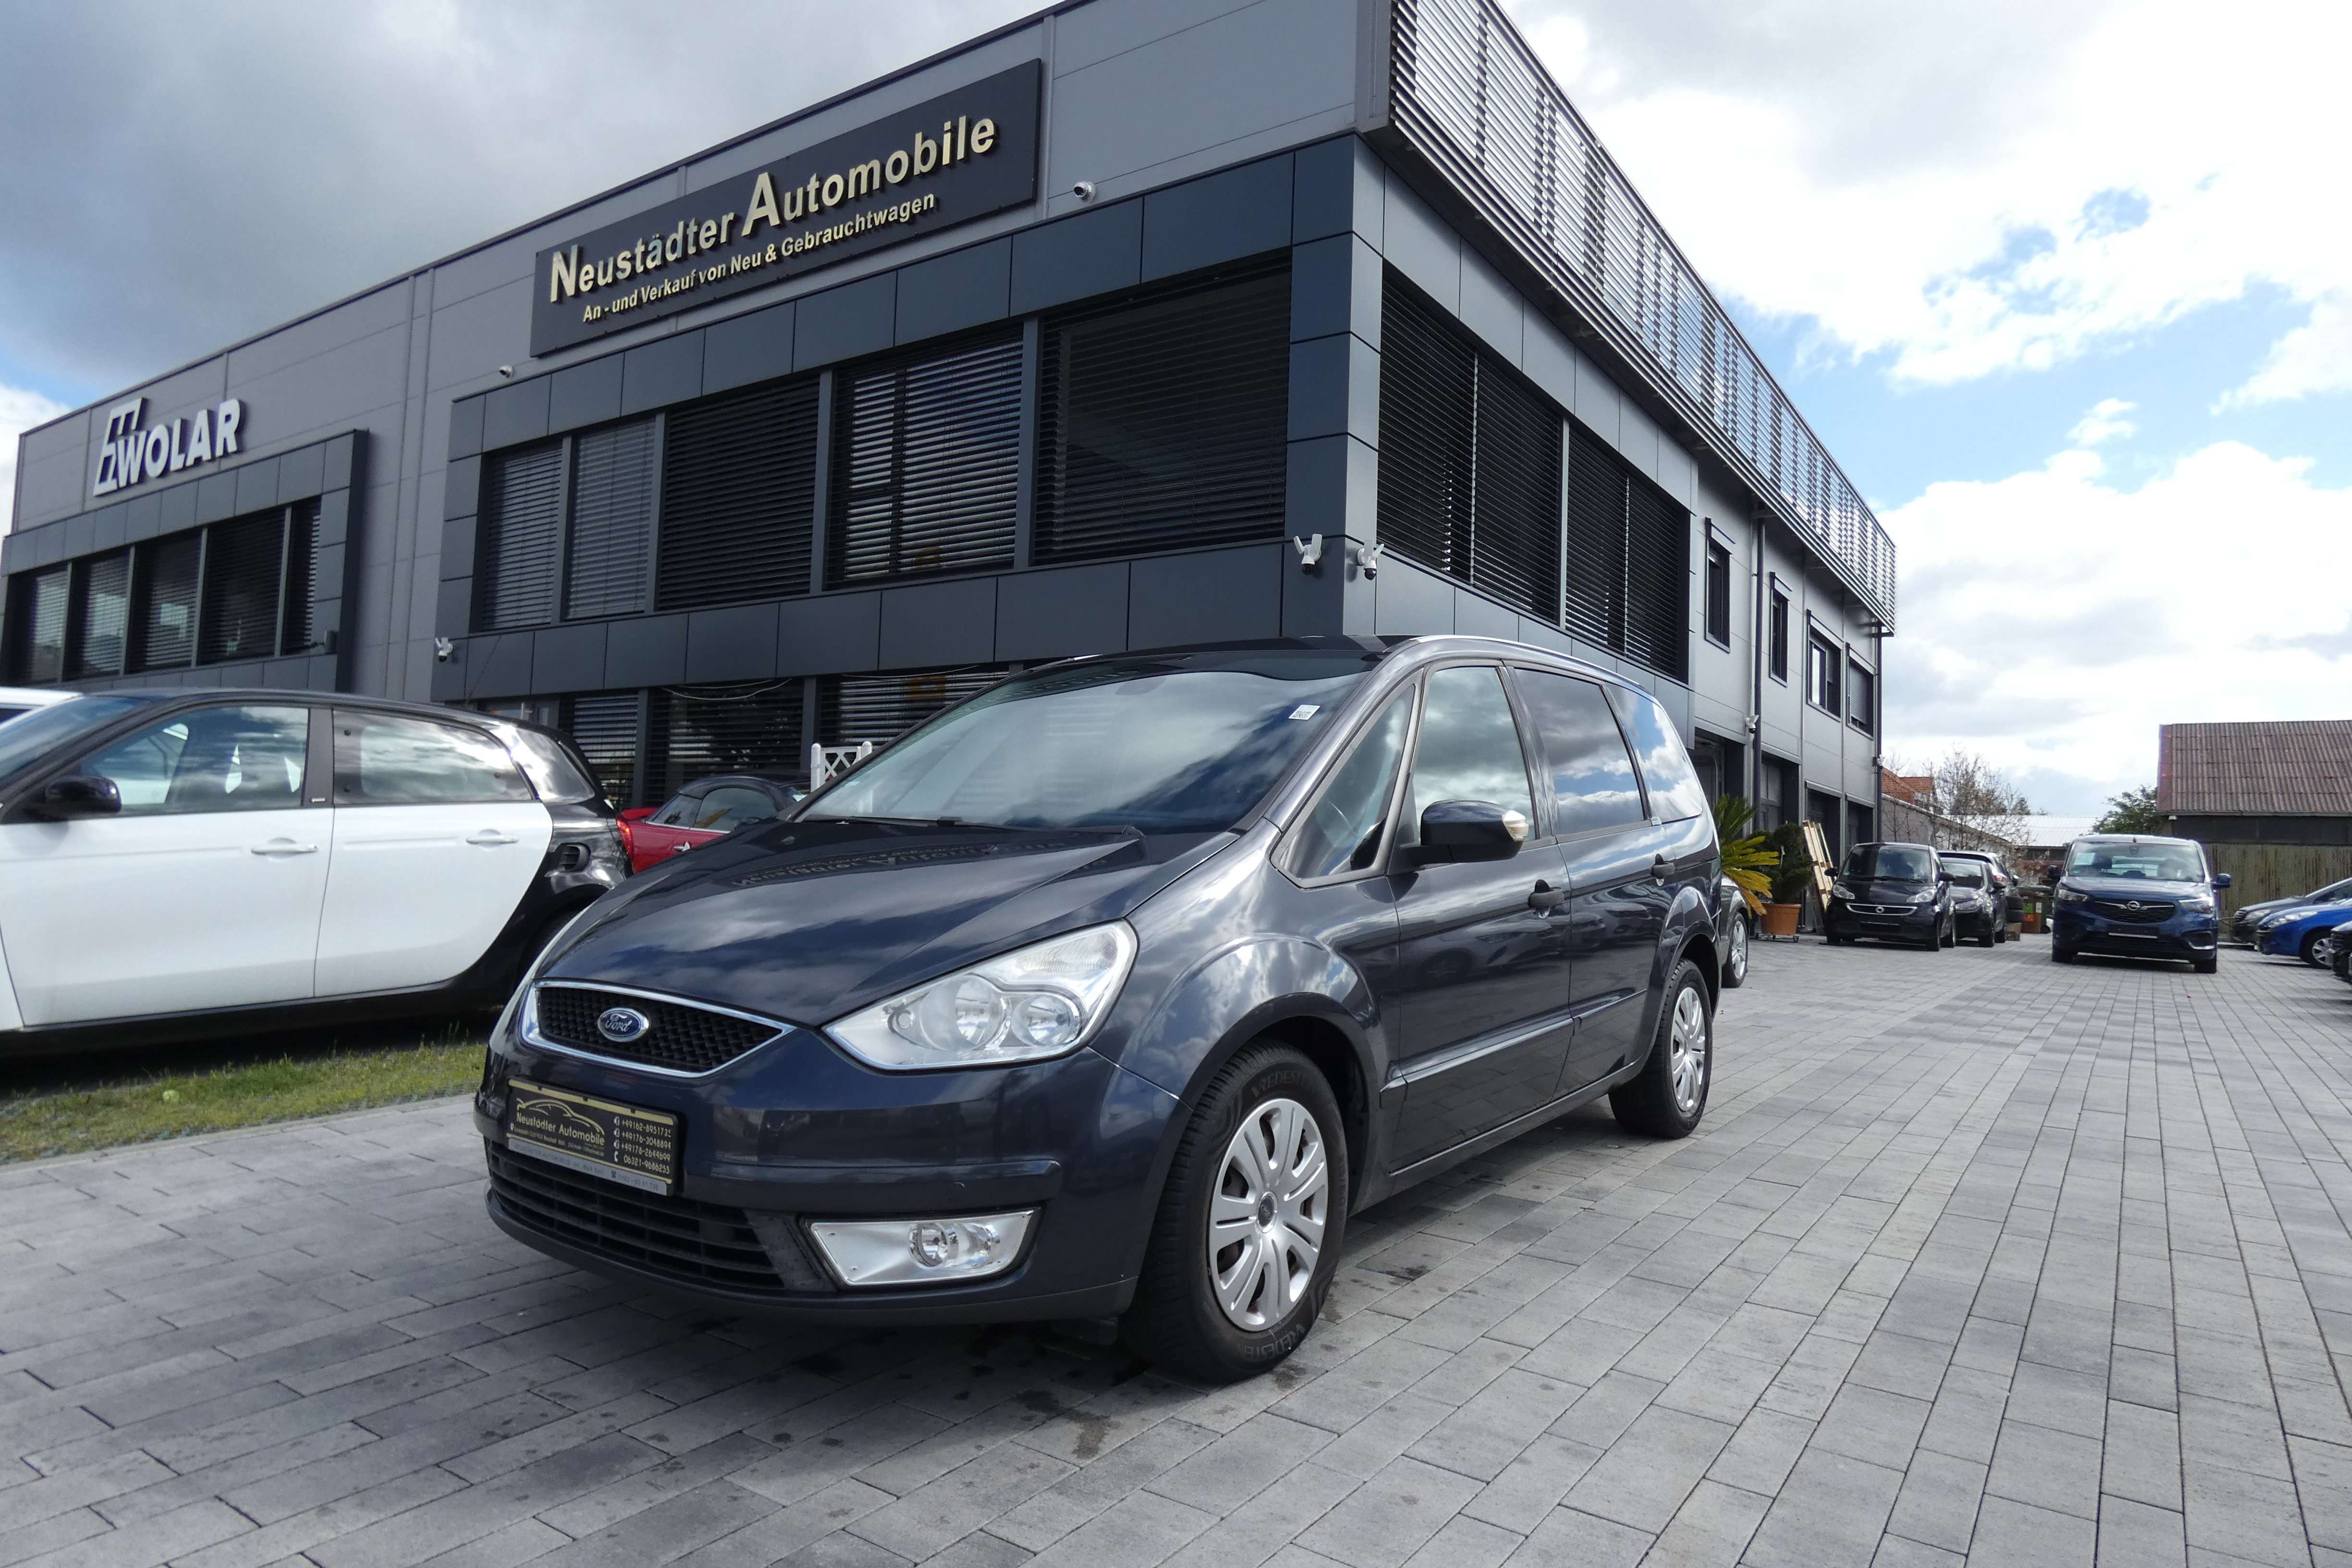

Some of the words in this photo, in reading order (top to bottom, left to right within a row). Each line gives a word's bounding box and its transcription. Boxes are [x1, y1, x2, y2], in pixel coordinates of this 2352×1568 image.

[551, 211, 735, 303] Neustädter
[741, 115, 996, 237] Automobile
[583, 305, 601, 323] An
[612, 288, 637, 313] und
[641, 269, 696, 304] Verkauf
[698, 263, 726, 284] von
[730, 251, 761, 274] Neu
[764, 243, 777, 263] &
[781, 194, 934, 258] Gebrauchtwagen
[605, 1014, 632, 1032] Ford
[516, 1112, 556, 1132] Neustädter
[559, 1124, 605, 1145] Automobile
